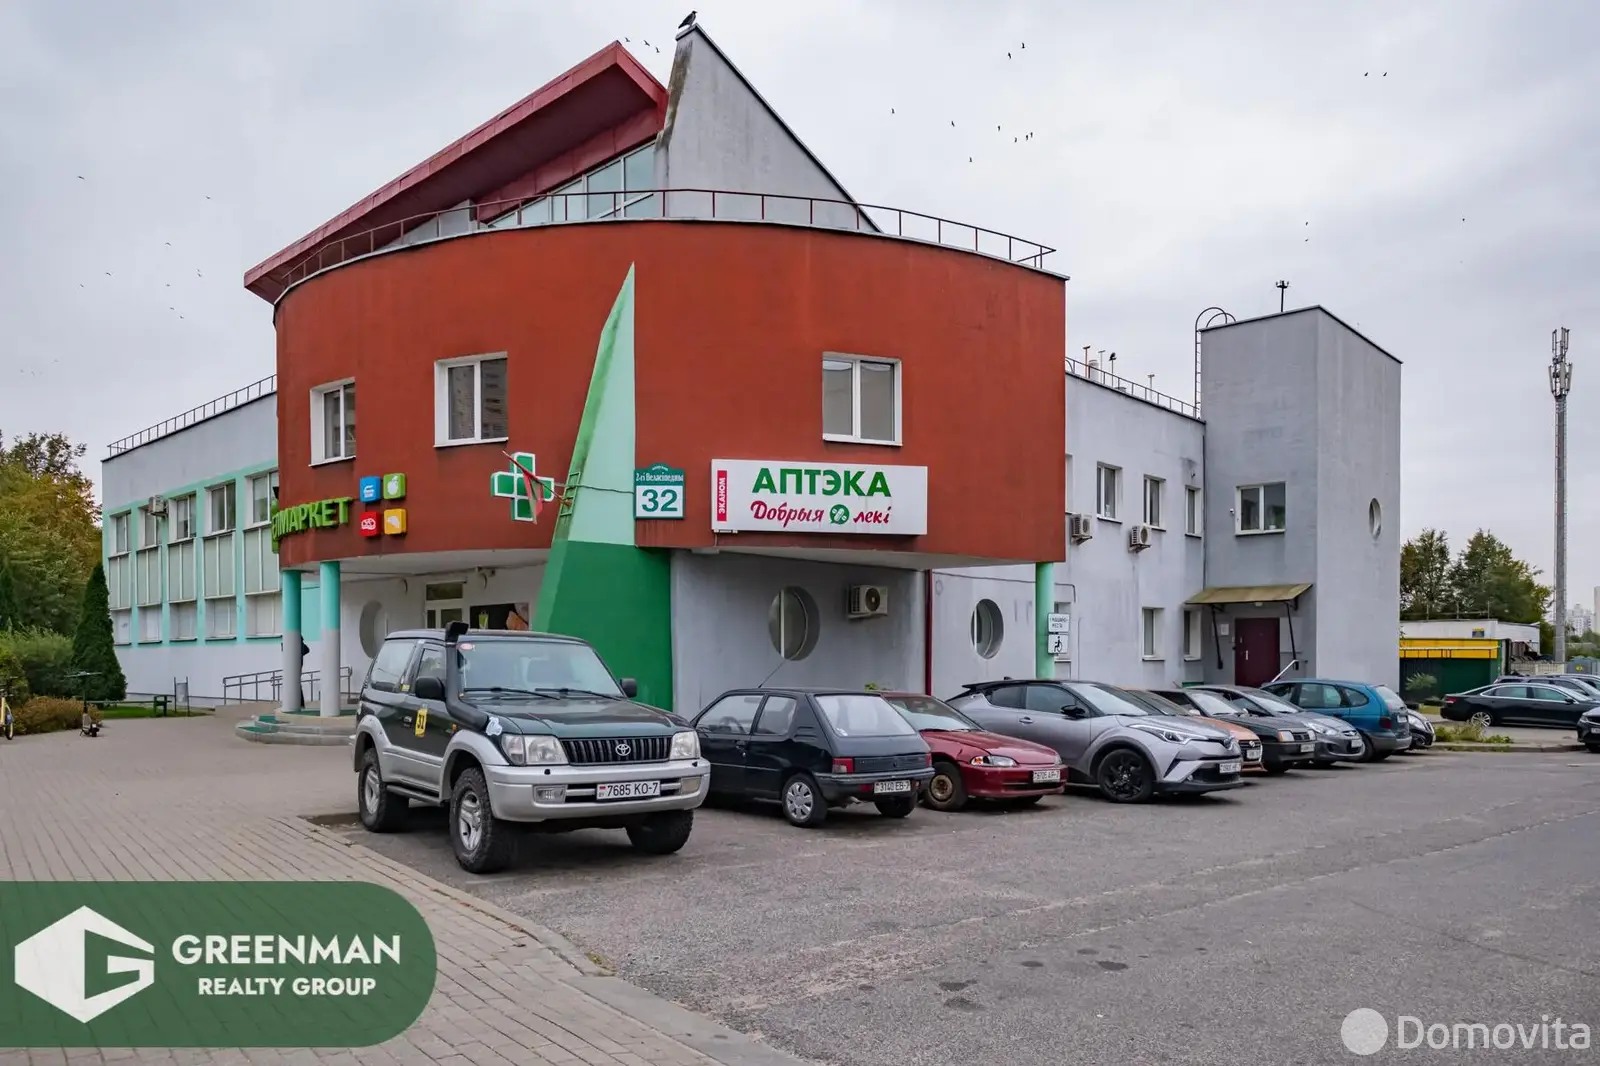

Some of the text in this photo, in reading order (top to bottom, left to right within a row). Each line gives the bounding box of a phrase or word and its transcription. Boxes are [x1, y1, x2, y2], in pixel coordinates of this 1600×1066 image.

[718, 477, 727, 514] ЭКАНОМ
[751, 467, 892, 497] АПТЭКА
[642, 488, 678, 512] 32
[750, 500, 892, 528] Добрыя лекі
[607, 782, 659, 797] 7685 KO-7
